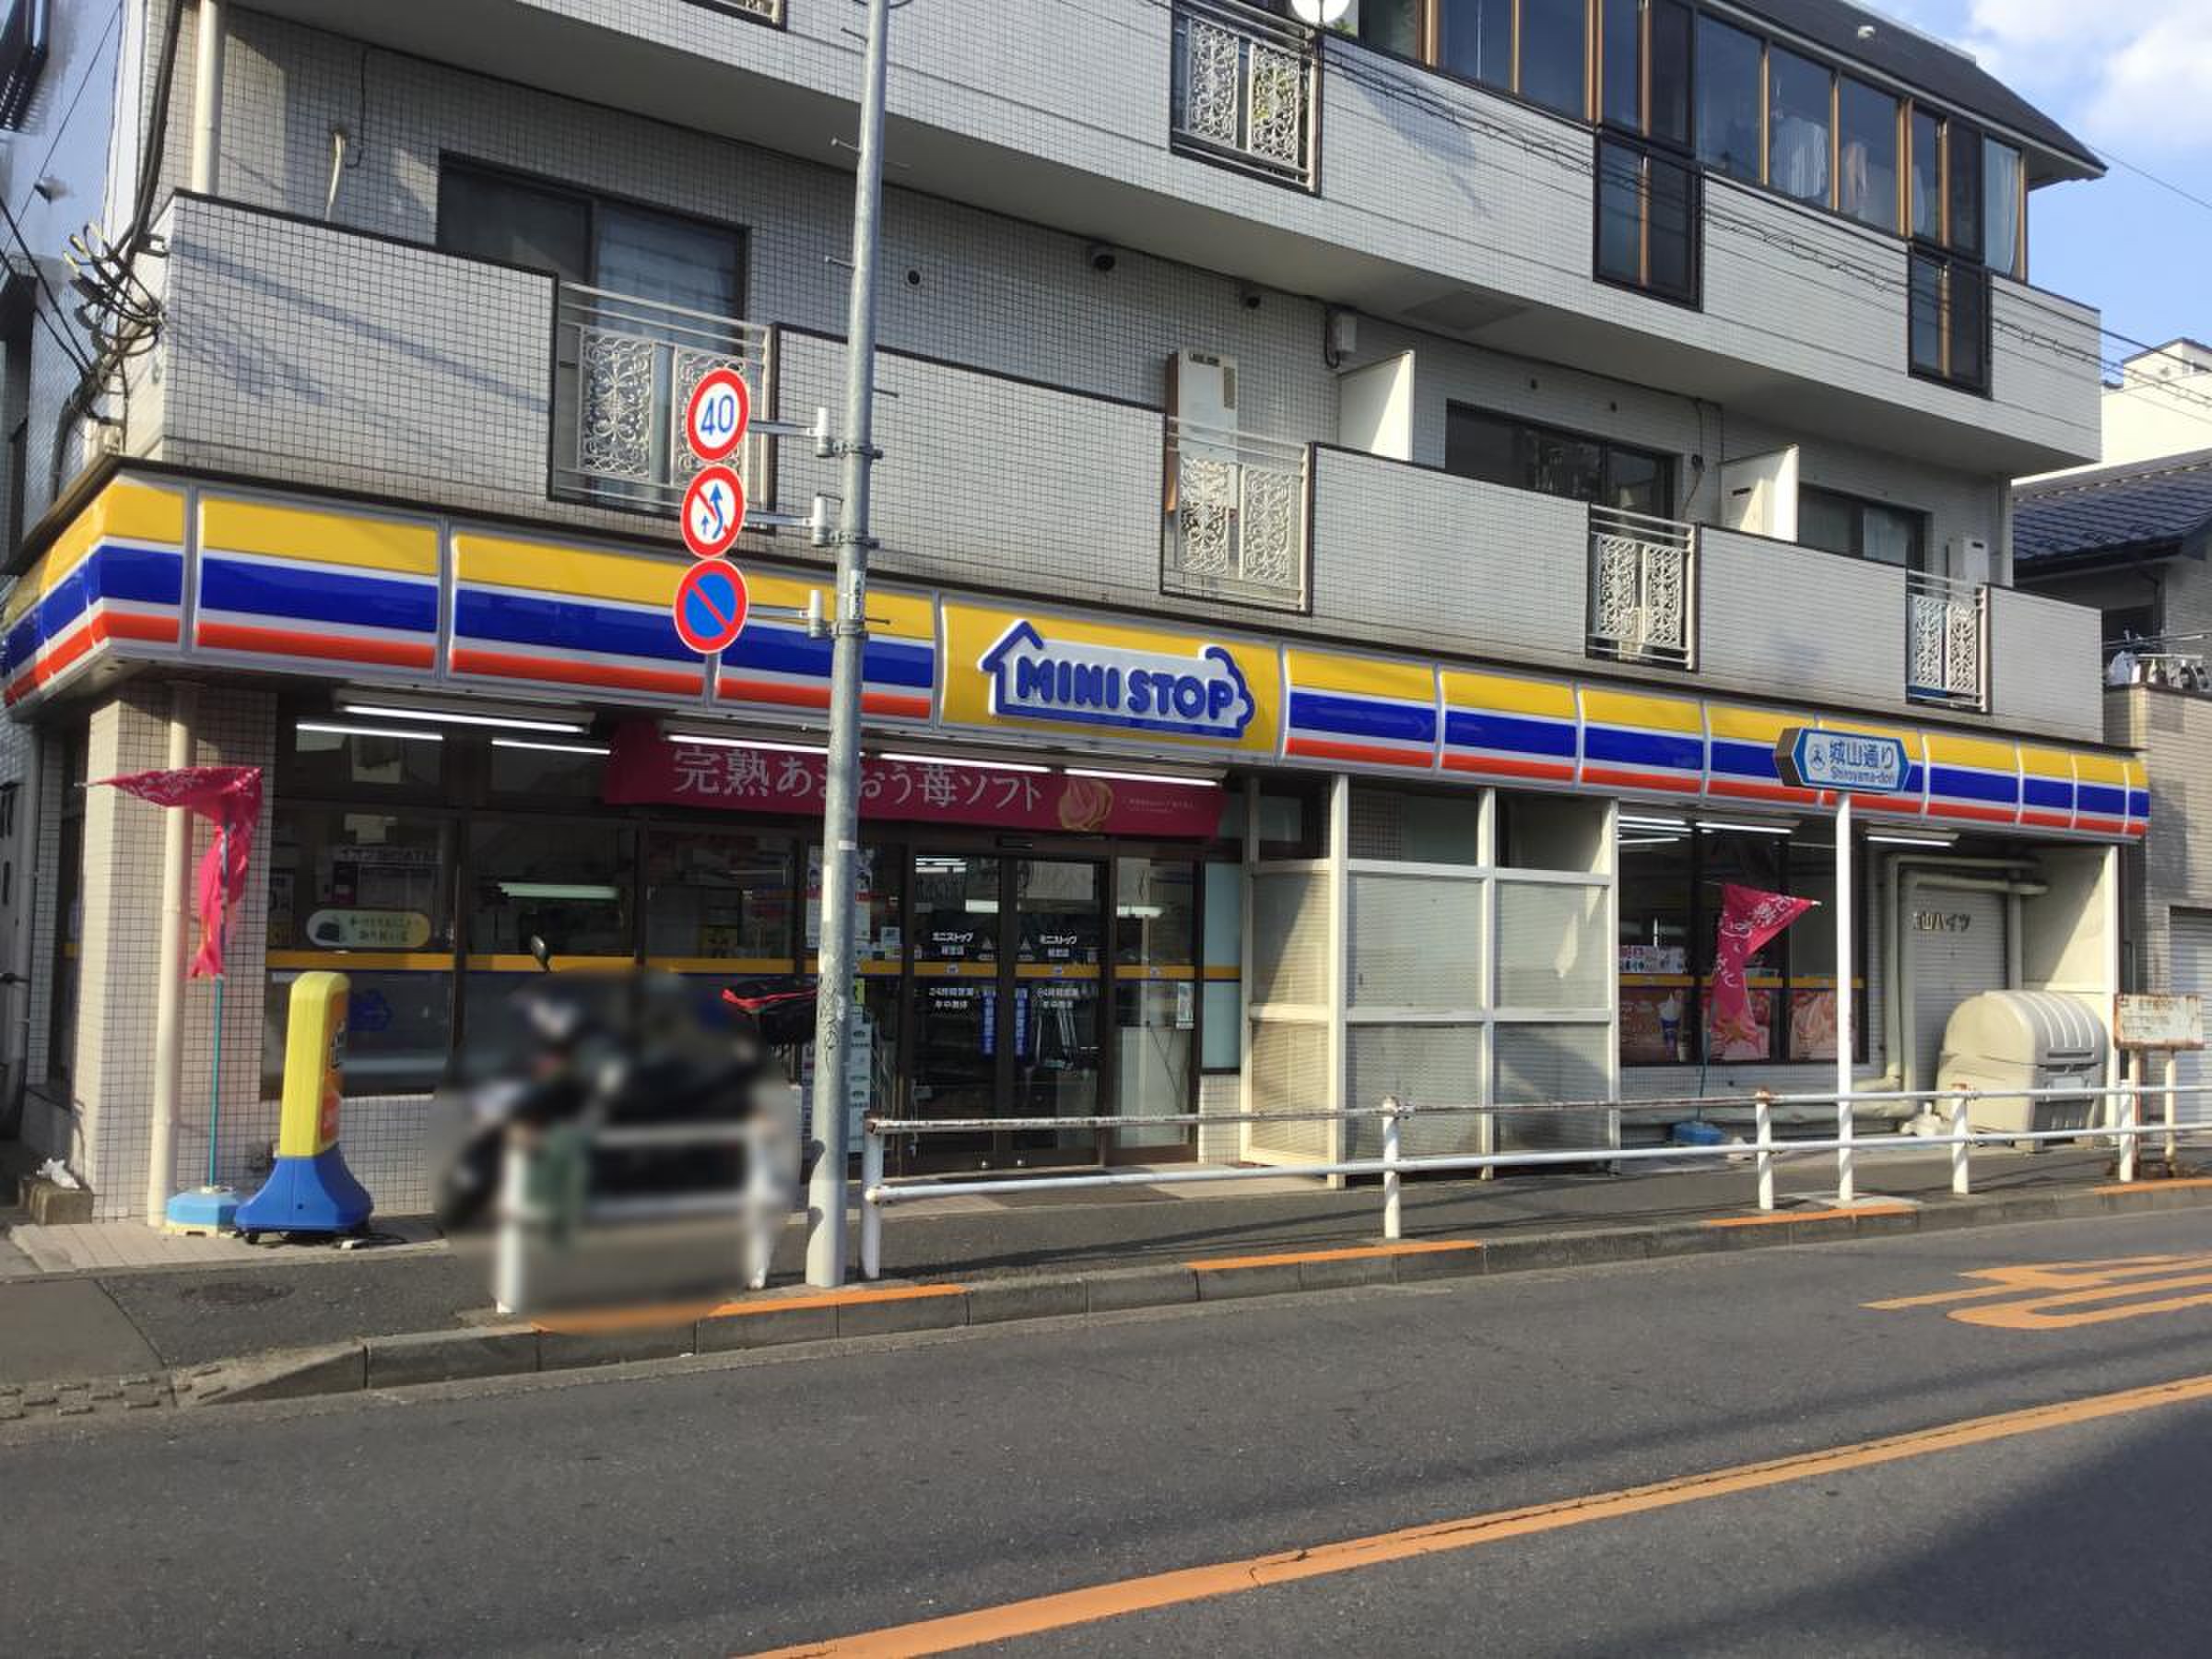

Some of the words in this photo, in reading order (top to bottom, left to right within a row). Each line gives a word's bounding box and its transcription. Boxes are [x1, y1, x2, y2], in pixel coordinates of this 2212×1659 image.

[700, 394, 735, 436] 40
[1829, 738, 1896, 770] 城山通り
[673, 744, 1042, 812] 完熟あおう苺ソフト
